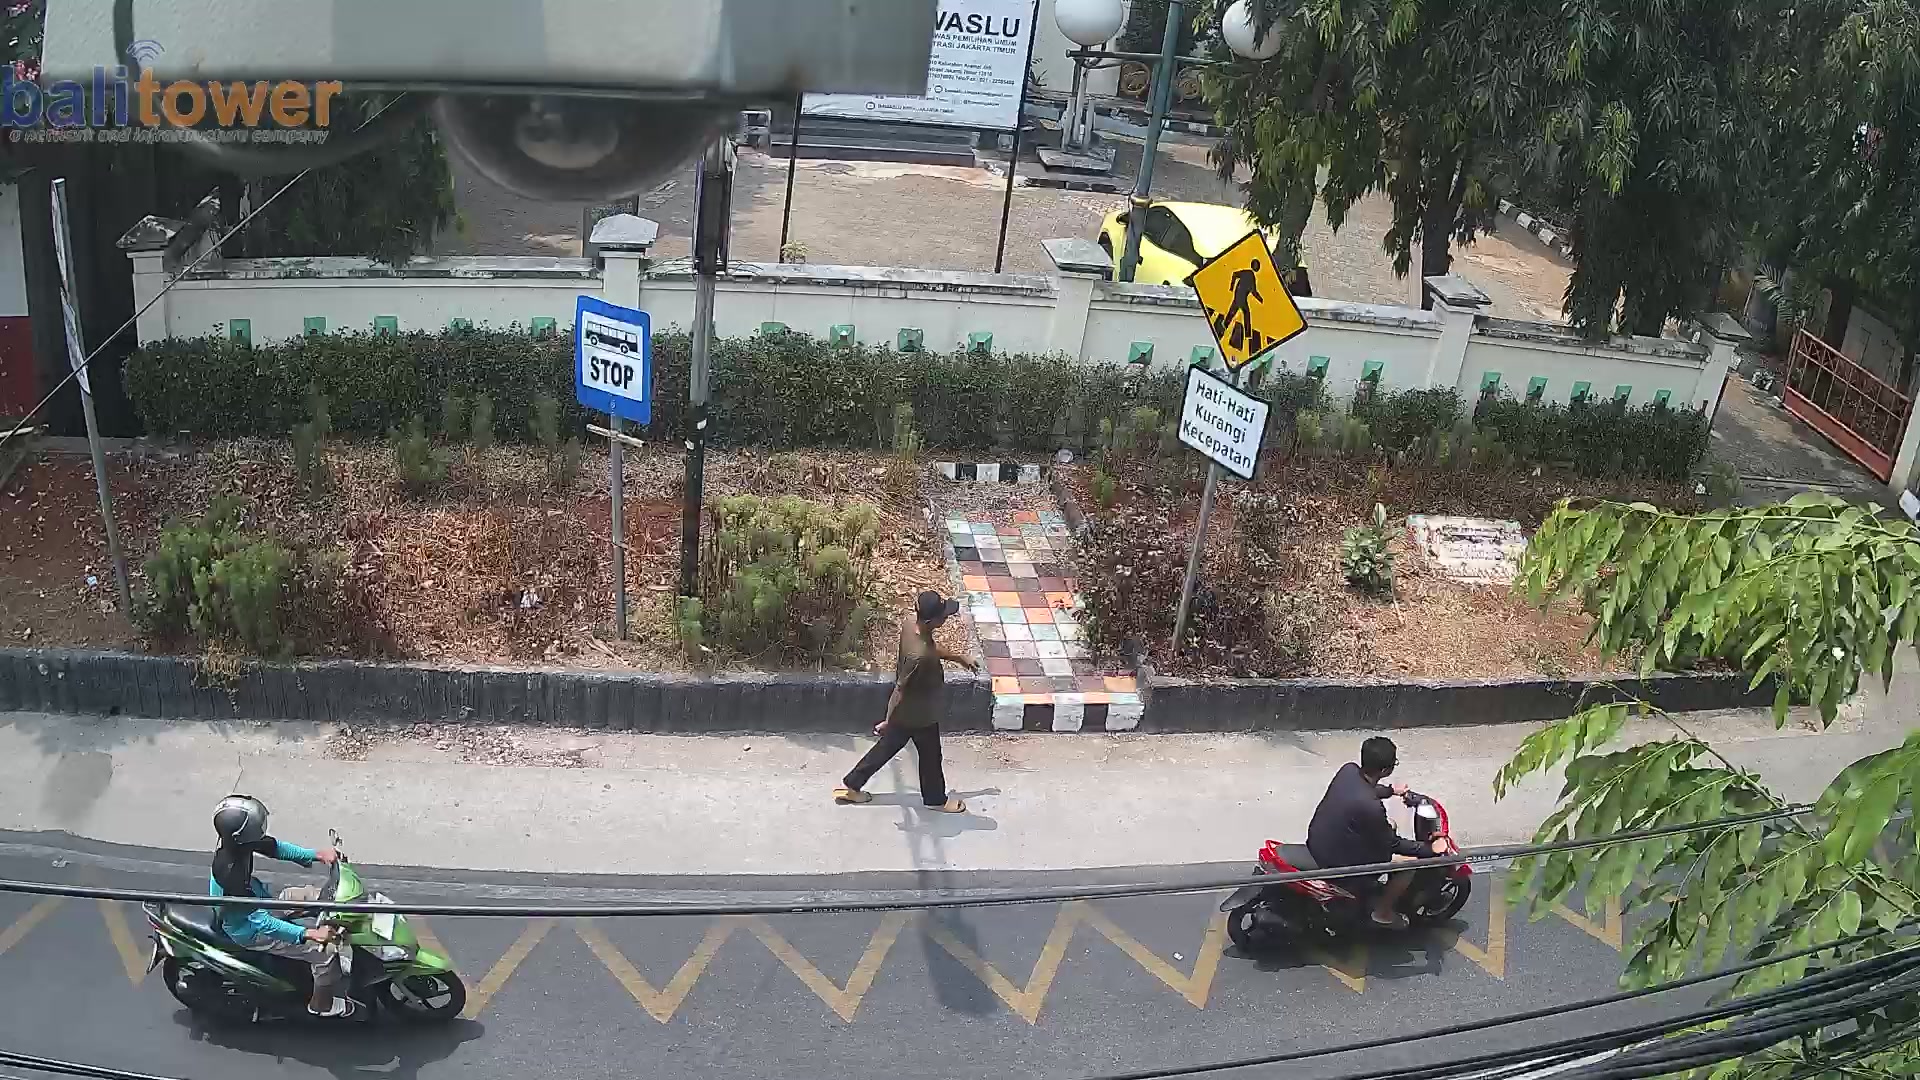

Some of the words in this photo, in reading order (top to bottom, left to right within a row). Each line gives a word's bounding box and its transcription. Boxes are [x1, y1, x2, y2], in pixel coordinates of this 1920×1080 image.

[956, 42, 991, 52] JAKARTA
[992, 46, 1016, 54] TIMUR
[590, 356, 634, 389] STOP
[1196, 379, 1256, 423] Hati-Hati
[1196, 404, 1247, 443] Kurangi
[1183, 420, 1251, 468] Kecepatan
